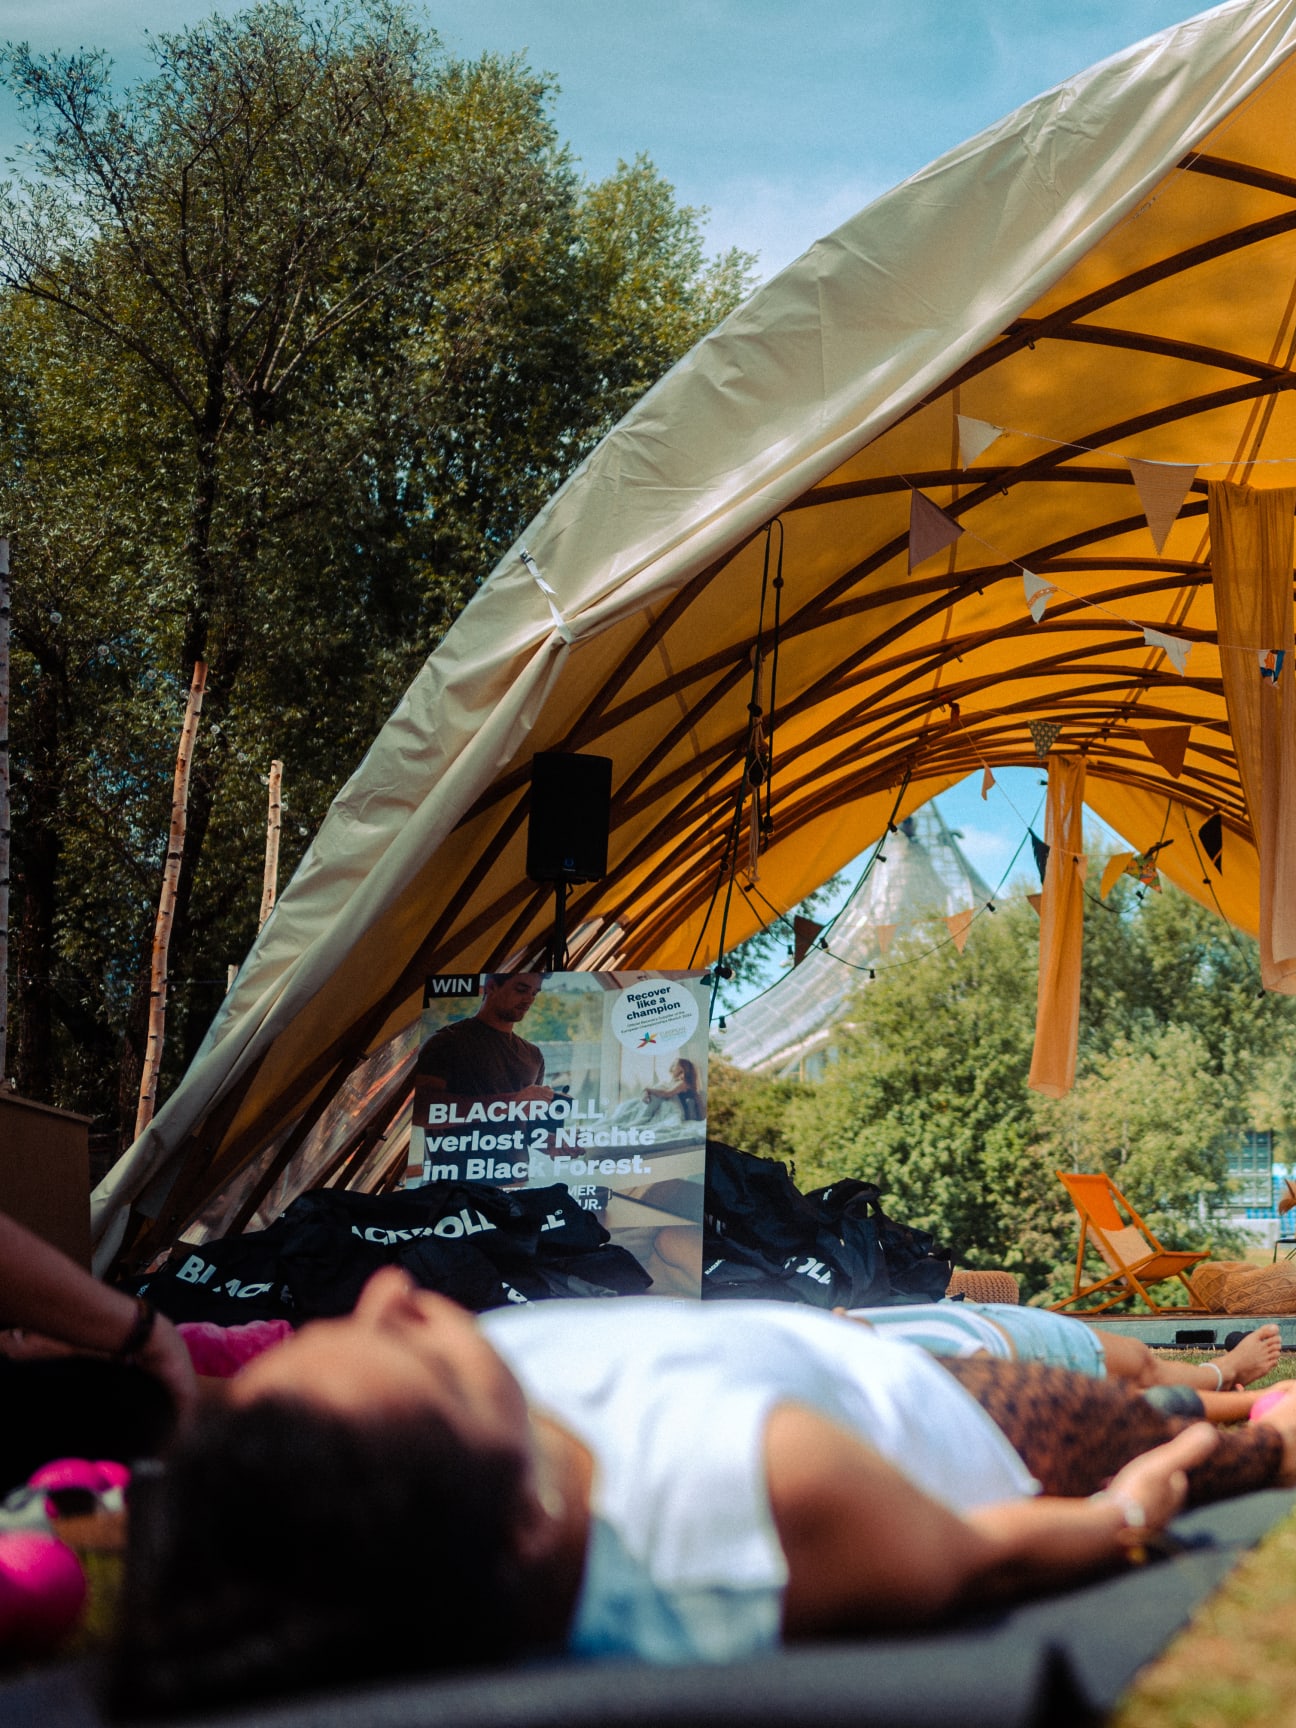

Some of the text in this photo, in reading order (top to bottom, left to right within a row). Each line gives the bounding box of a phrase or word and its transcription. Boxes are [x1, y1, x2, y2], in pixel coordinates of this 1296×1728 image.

[432, 978, 473, 993] WIN
[626, 986, 672, 1003] Recover
[626, 1001, 681, 1020] champion
[636, 996, 666, 1010] like a
[425, 1125, 656, 1153] verlost 2 Nächte
[423, 1154, 652, 1182] im Black Forest.
